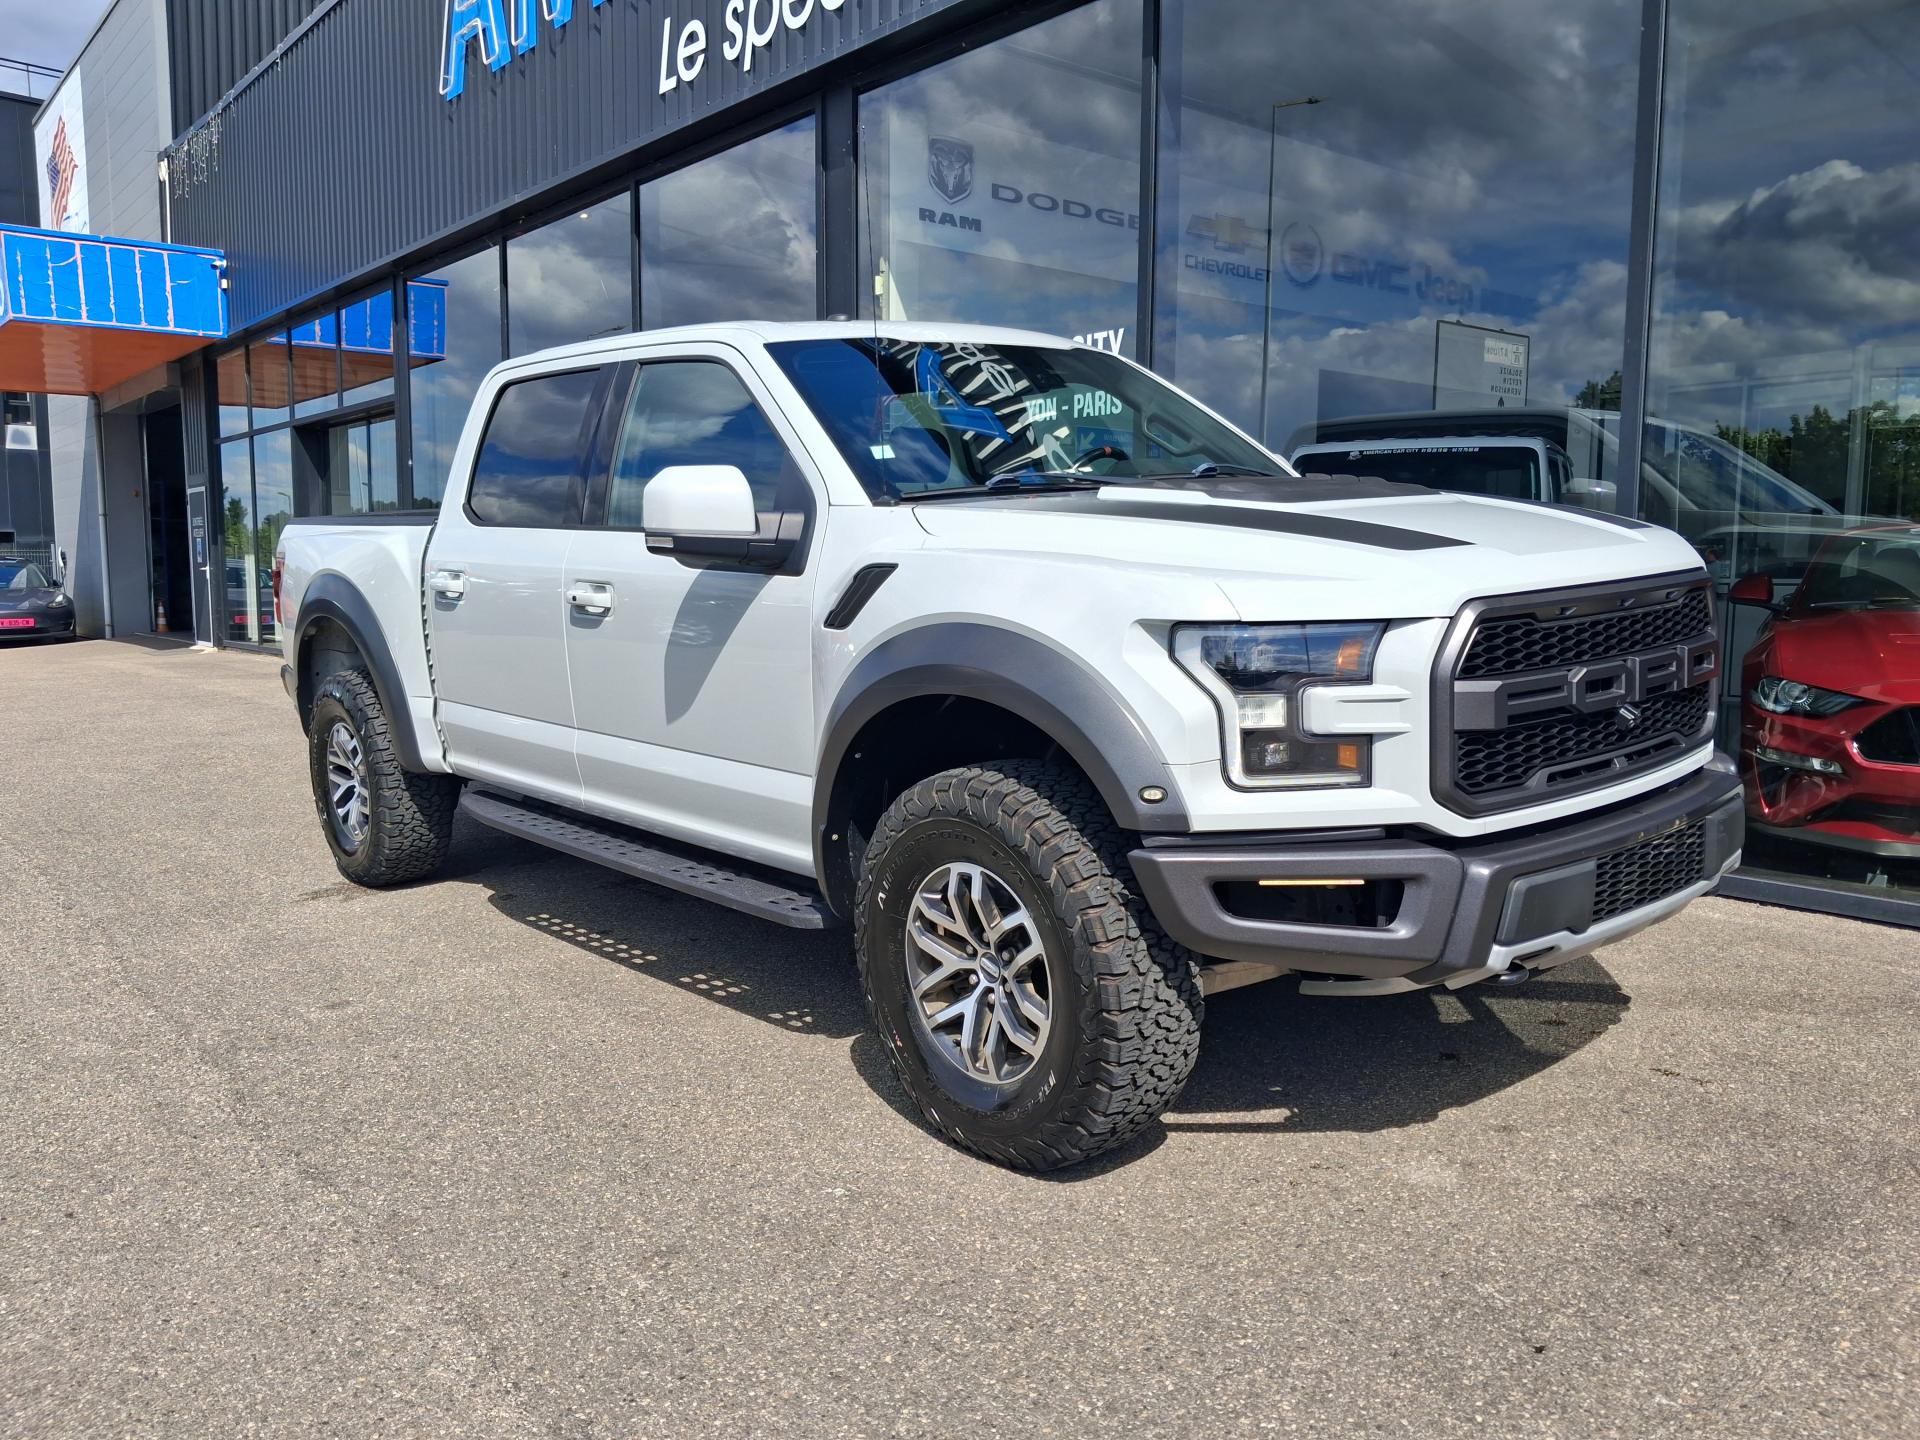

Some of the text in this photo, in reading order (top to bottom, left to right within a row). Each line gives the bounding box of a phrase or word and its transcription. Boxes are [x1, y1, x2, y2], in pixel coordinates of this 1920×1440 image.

[658, 16, 707, 95] Le
[918, 207, 982, 232] RAM
[1184, 254, 1271, 282] CHEVROLET
[1025, 397, 1057, 421] YON
[1073, 390, 1122, 418] PARIS
[1492, 642, 1720, 730] FORD
